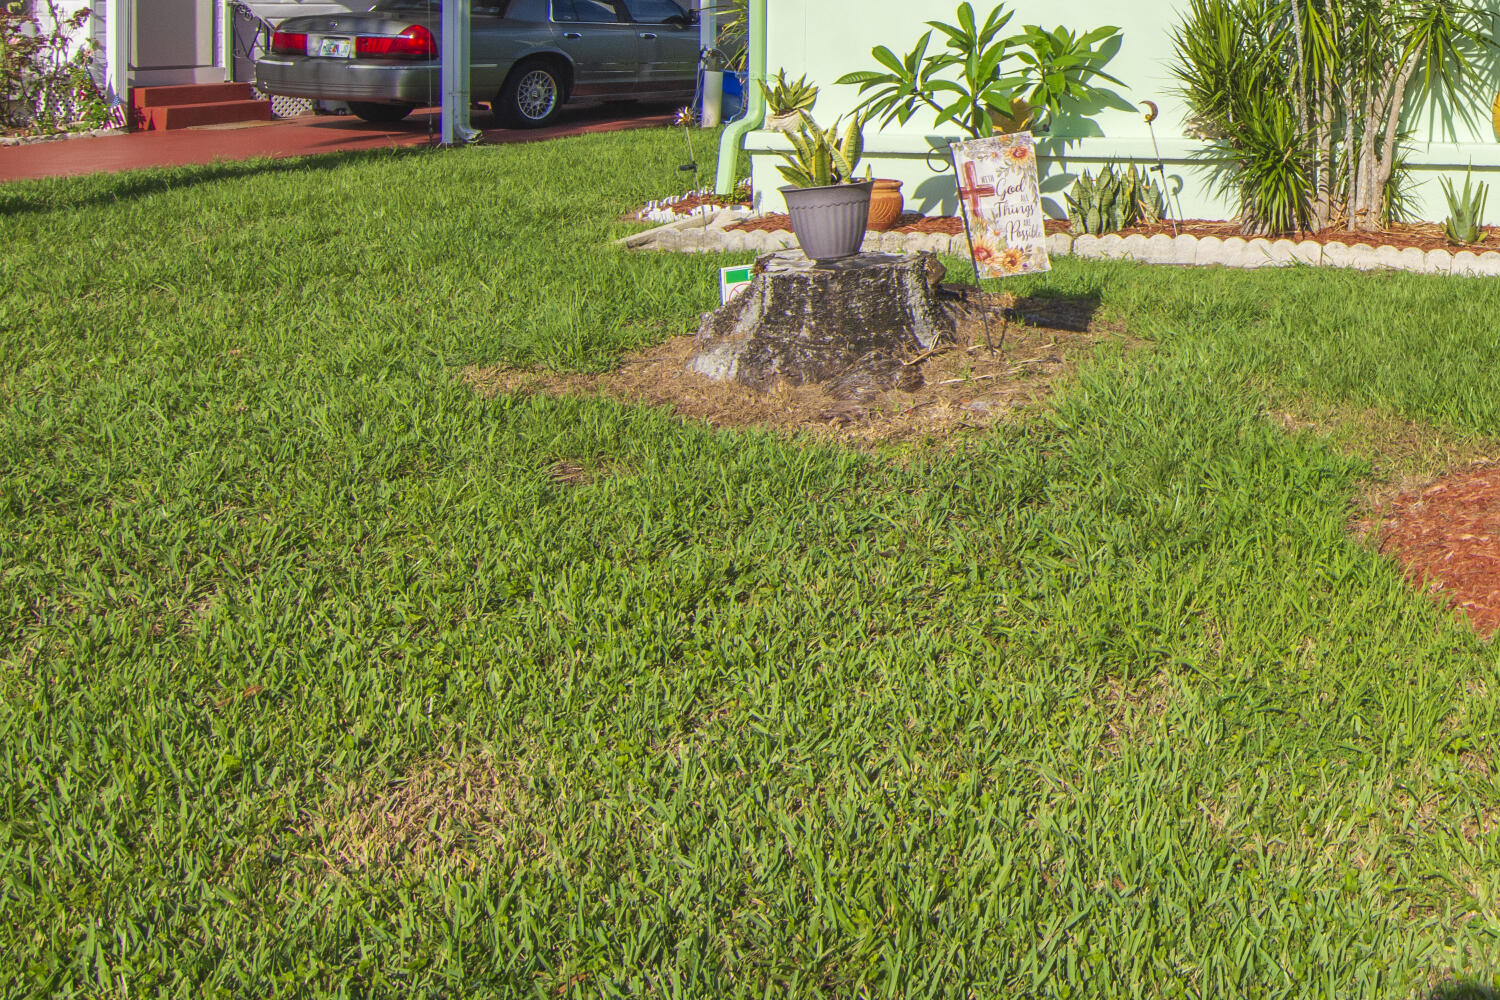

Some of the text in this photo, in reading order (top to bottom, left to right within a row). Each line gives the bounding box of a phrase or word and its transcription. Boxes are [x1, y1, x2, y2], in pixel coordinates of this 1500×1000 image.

[996, 176, 1024, 200] God
[994, 200, 1034, 217] Things
[1006, 219, 1042, 241] Possible
